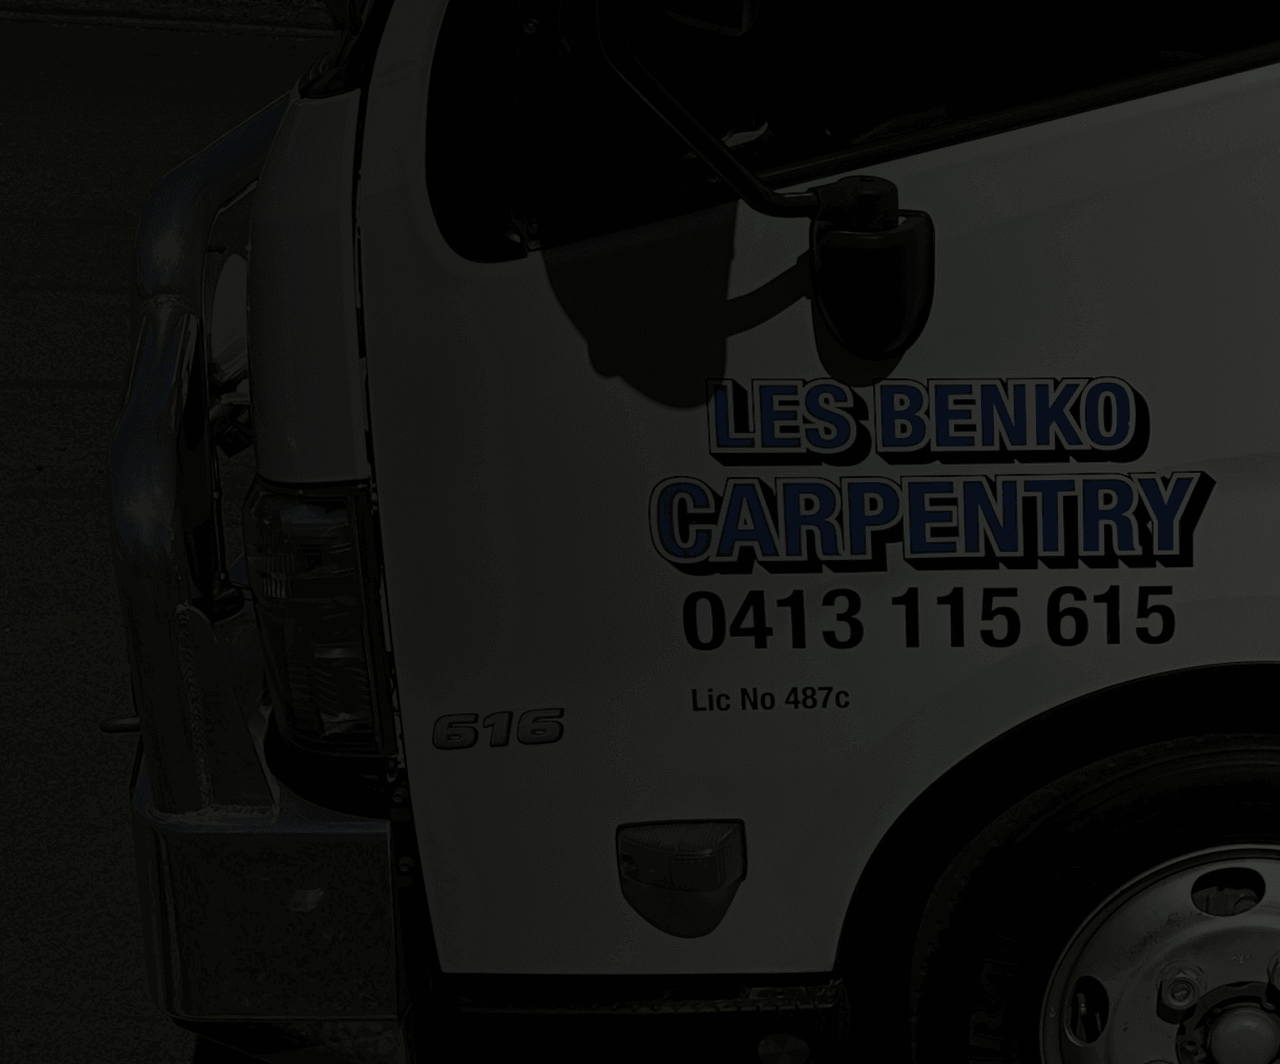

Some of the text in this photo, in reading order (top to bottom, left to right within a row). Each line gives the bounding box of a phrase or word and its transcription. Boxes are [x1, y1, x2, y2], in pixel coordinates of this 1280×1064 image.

[706, 376, 1150, 466] LES BENKO
[649, 471, 1216, 576] CARPENTRY
[682, 585, 1177, 651] 0413 115 615
[431, 707, 565, 751] 616
[690, 686, 850, 712] Lic No 487c
